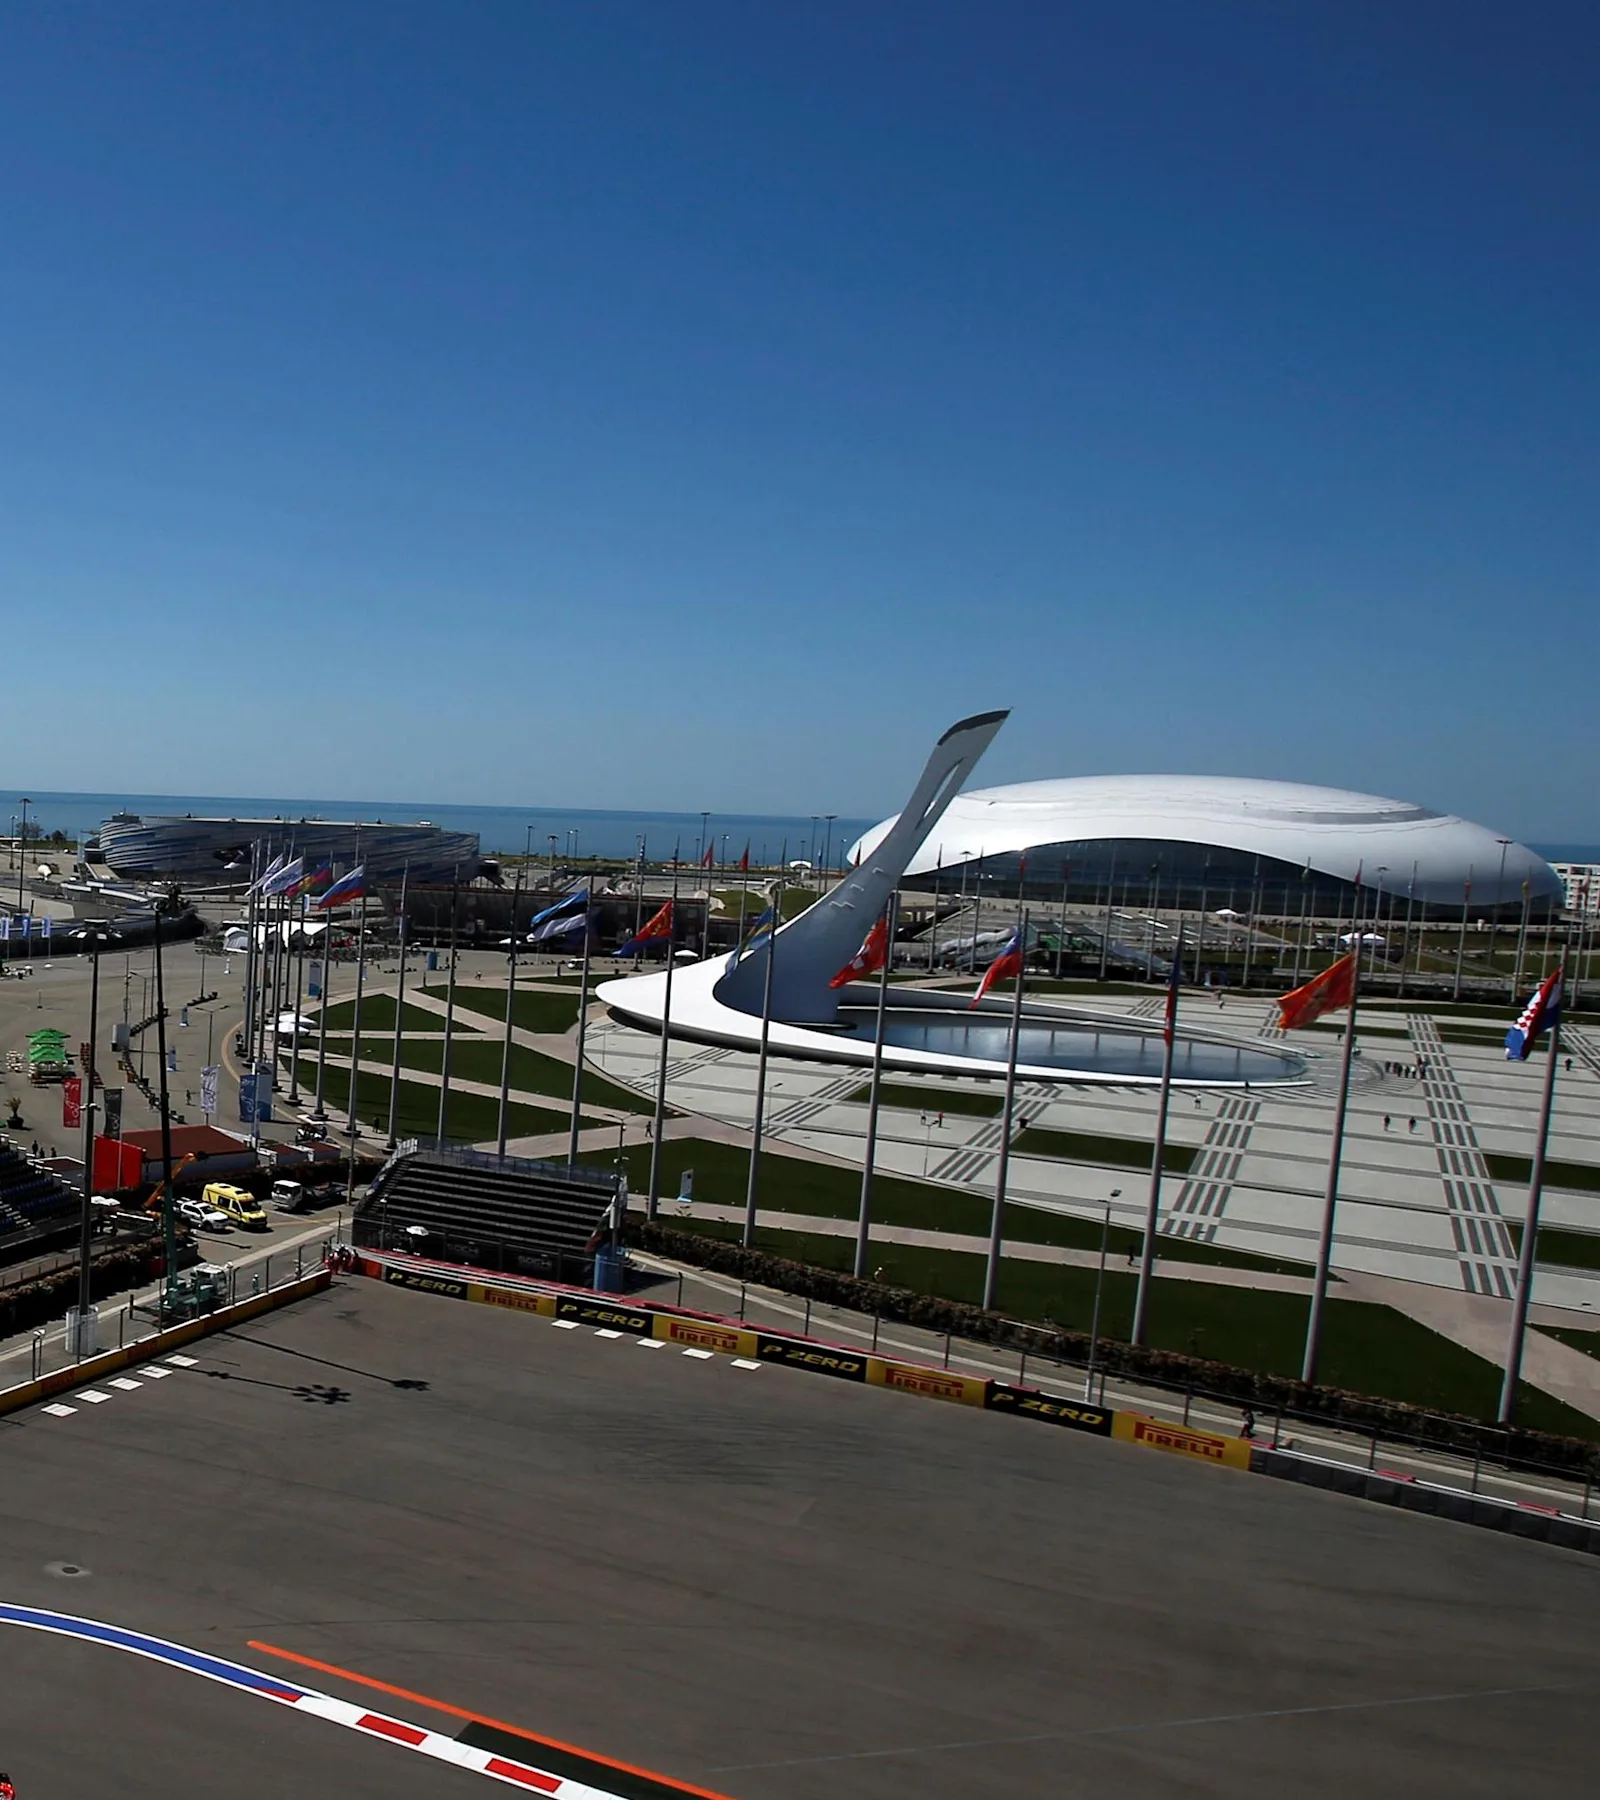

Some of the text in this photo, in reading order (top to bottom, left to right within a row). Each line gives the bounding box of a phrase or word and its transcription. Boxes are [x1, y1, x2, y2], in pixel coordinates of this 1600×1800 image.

[388, 1271, 462, 1295] P ZERO
[484, 1289, 539, 1311] PIRELLI
[559, 1302, 647, 1329] P ZERO
[669, 1322, 739, 1350] PIRELLI
[762, 1343, 861, 1373] P ZERO
[885, 1367, 965, 1399] PIRELLI
[991, 1391, 1105, 1426] P ZERO
[1134, 1421, 1226, 1459] PIRELLI
